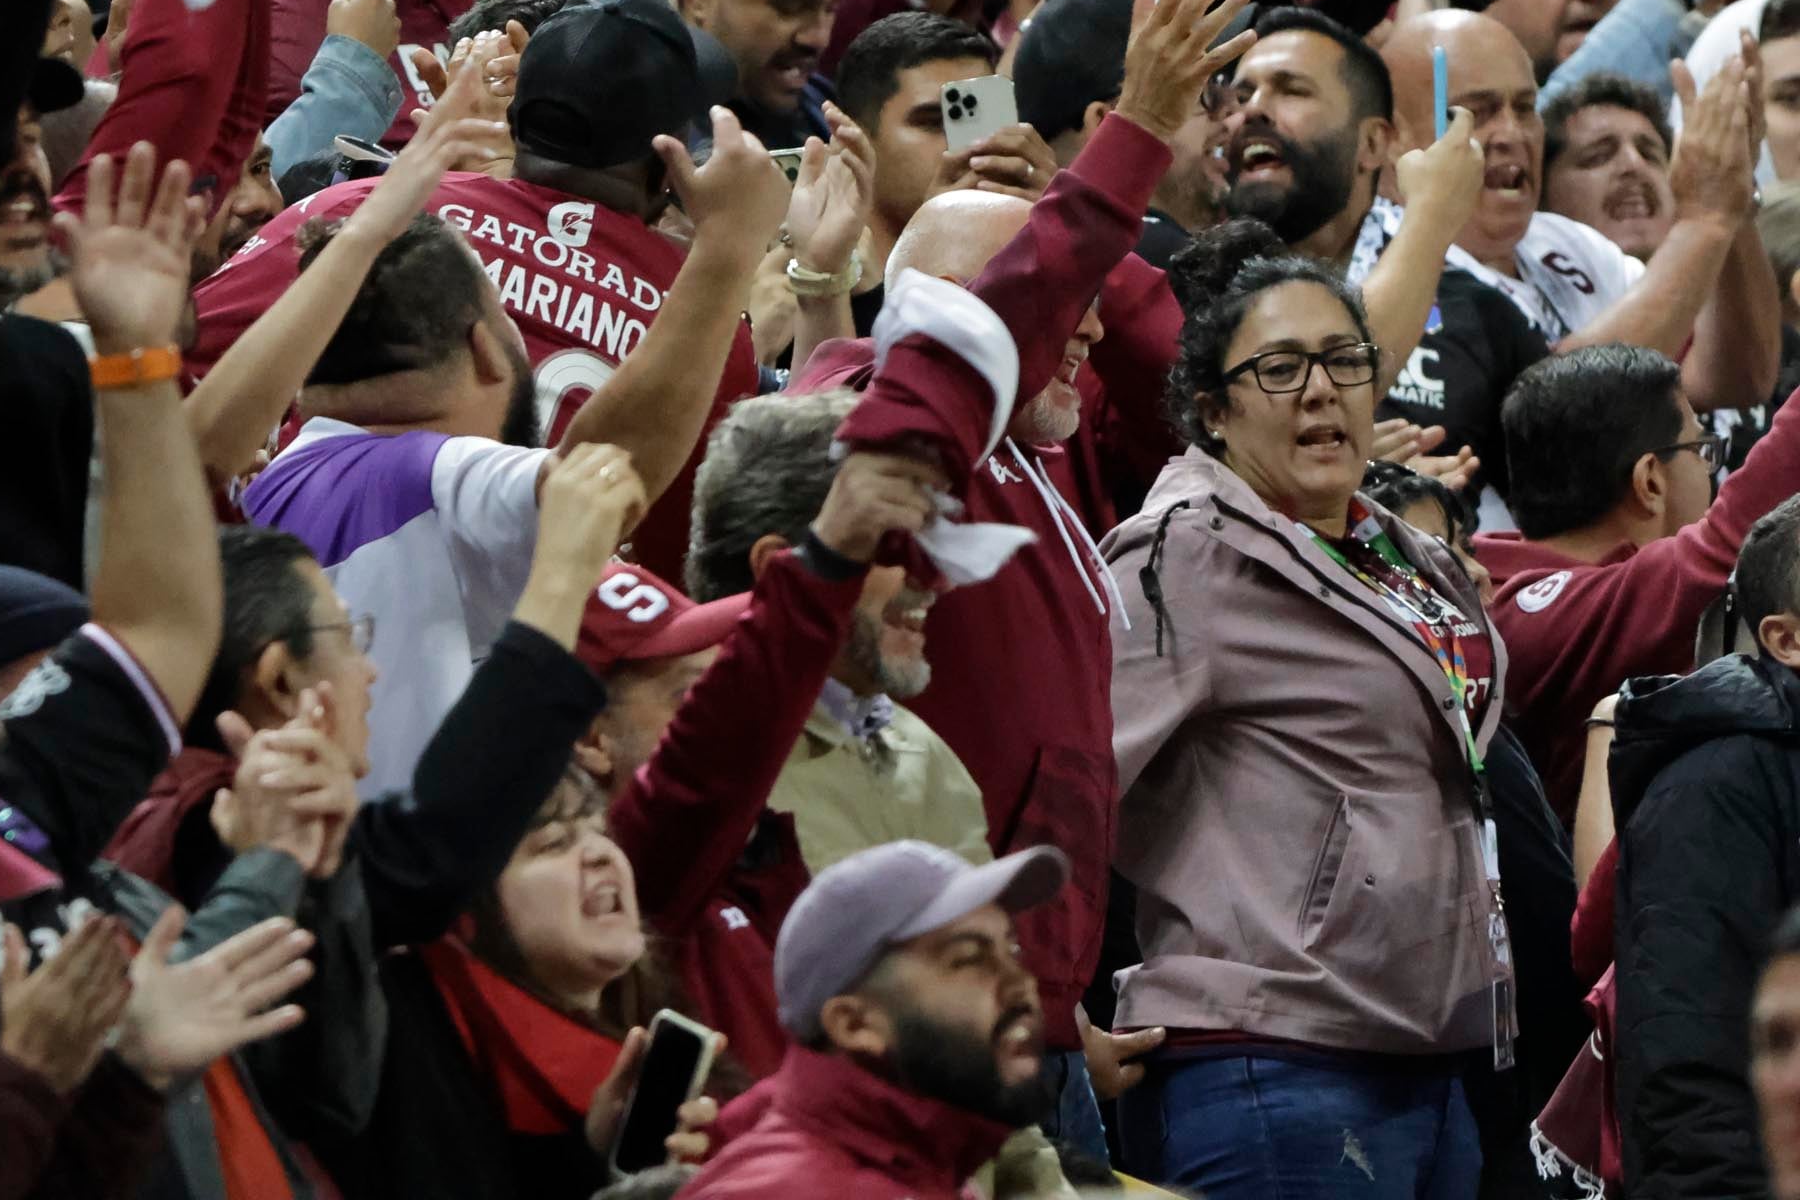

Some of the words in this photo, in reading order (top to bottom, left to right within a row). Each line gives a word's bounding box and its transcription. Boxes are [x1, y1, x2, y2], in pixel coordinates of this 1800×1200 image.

[438, 204, 670, 311] GATORAD
[1542, 252, 1595, 294] S
[598, 572, 670, 623] S
